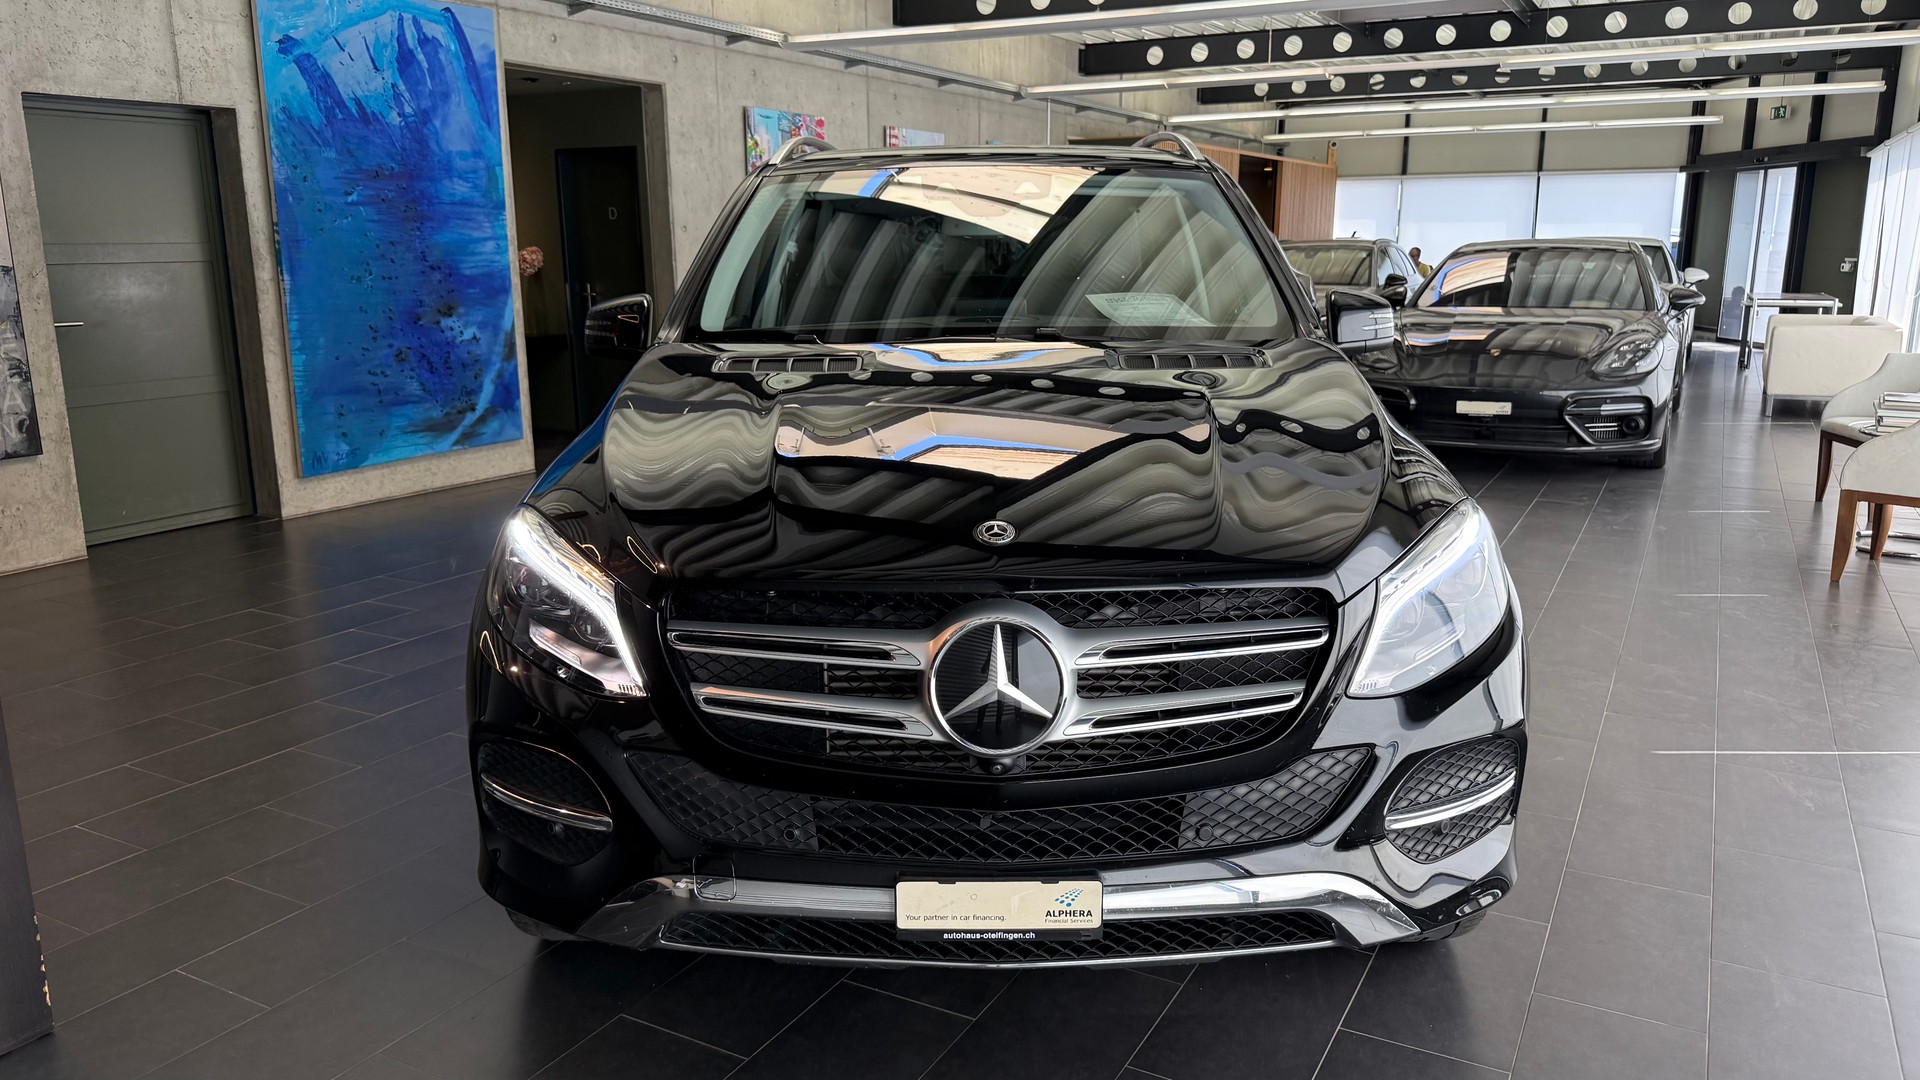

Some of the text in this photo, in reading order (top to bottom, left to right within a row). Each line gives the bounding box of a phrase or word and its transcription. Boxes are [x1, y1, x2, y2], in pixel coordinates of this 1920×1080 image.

[608, 207, 618, 220] D
[923, 914, 949, 922] partner
[972, 914, 1007, 922] financing.
[1045, 910, 1093, 918] ALPHERA
[943, 932, 1036, 940] autohaus-otelfingen.ch
